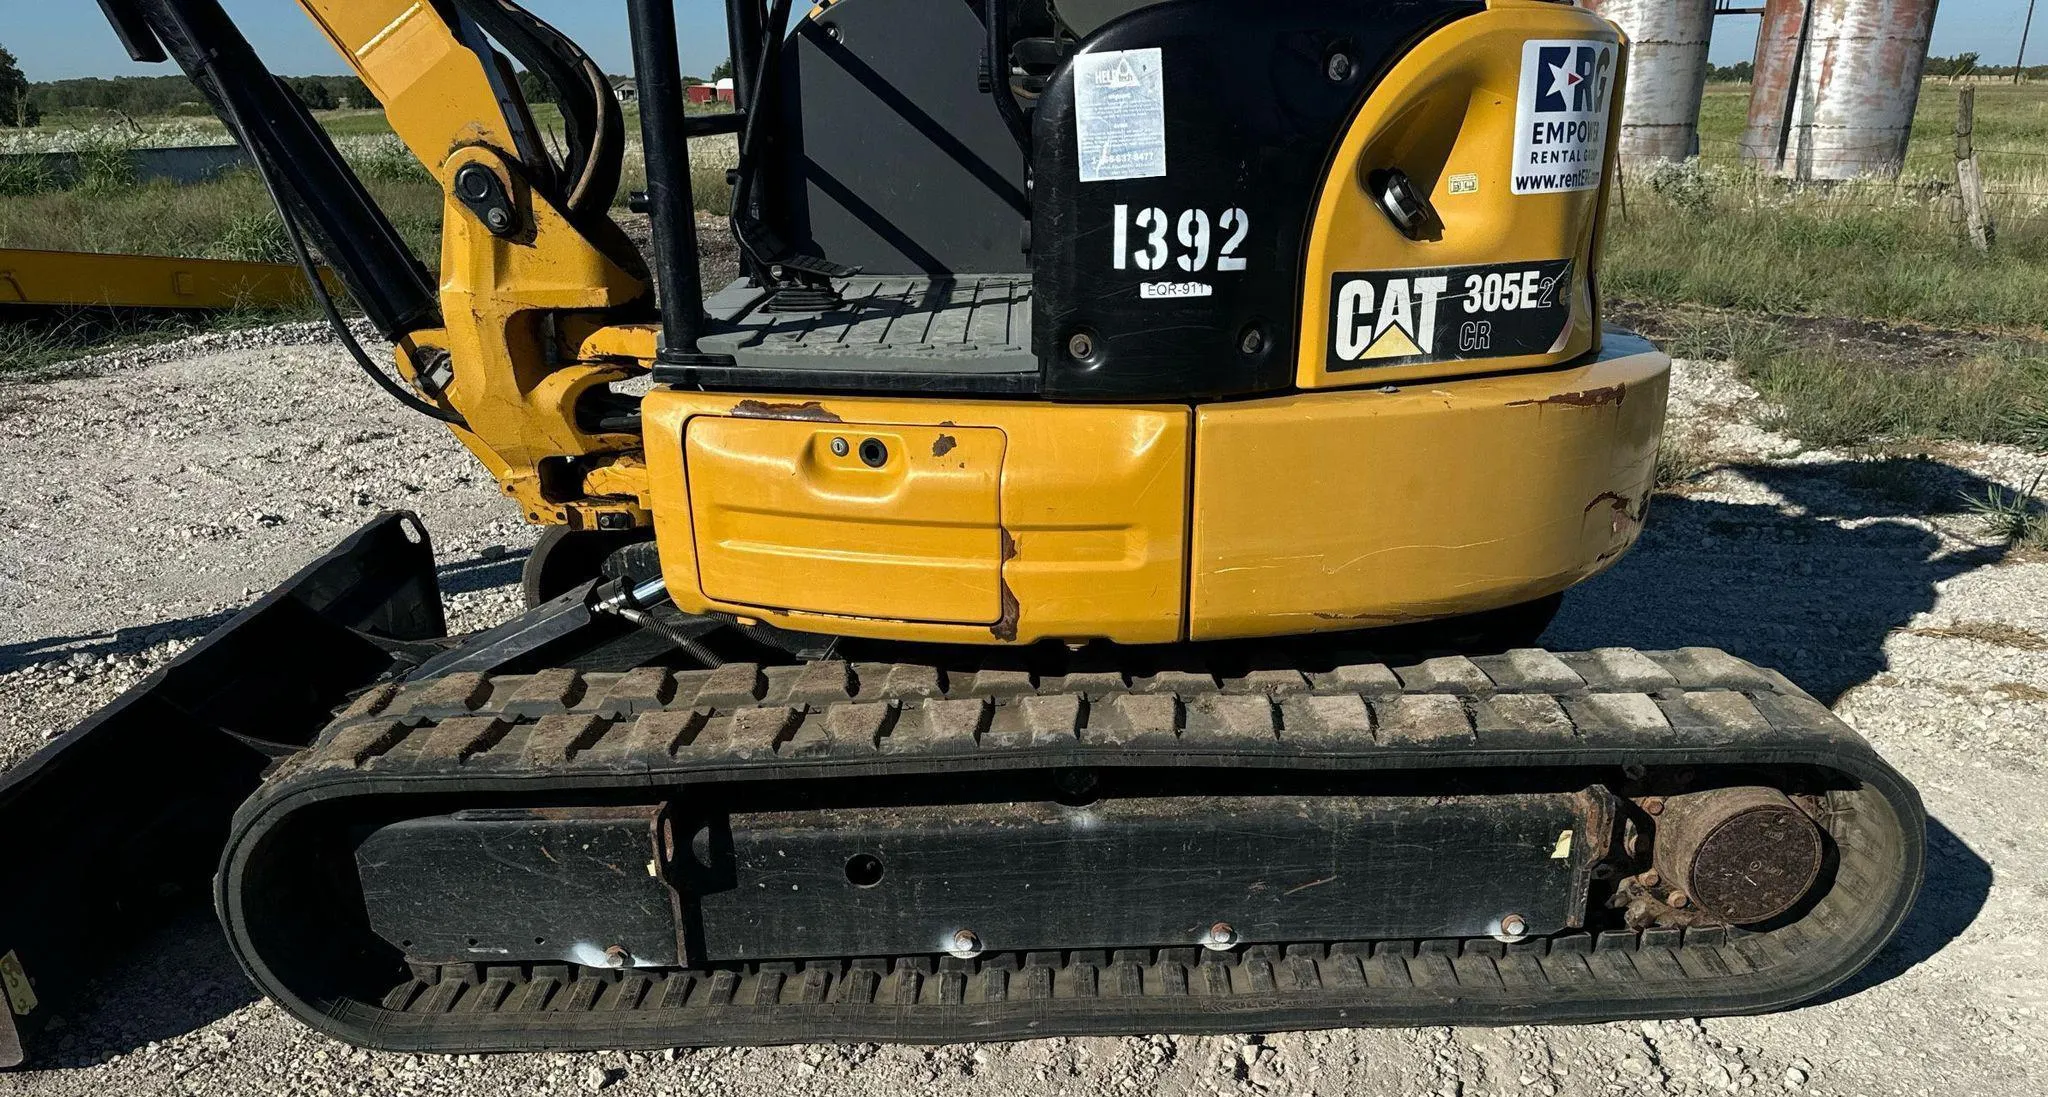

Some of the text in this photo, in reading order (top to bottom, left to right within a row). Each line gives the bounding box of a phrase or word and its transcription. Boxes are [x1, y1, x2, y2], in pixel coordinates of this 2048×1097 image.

[1530, 150, 1581, 165] RENTAL
[1113, 204, 1250, 272] 1392
[1147, 283, 1205, 297] EQR-911
[1335, 270, 1555, 361] CAT 305E2
[1459, 320, 1492, 351] CR
